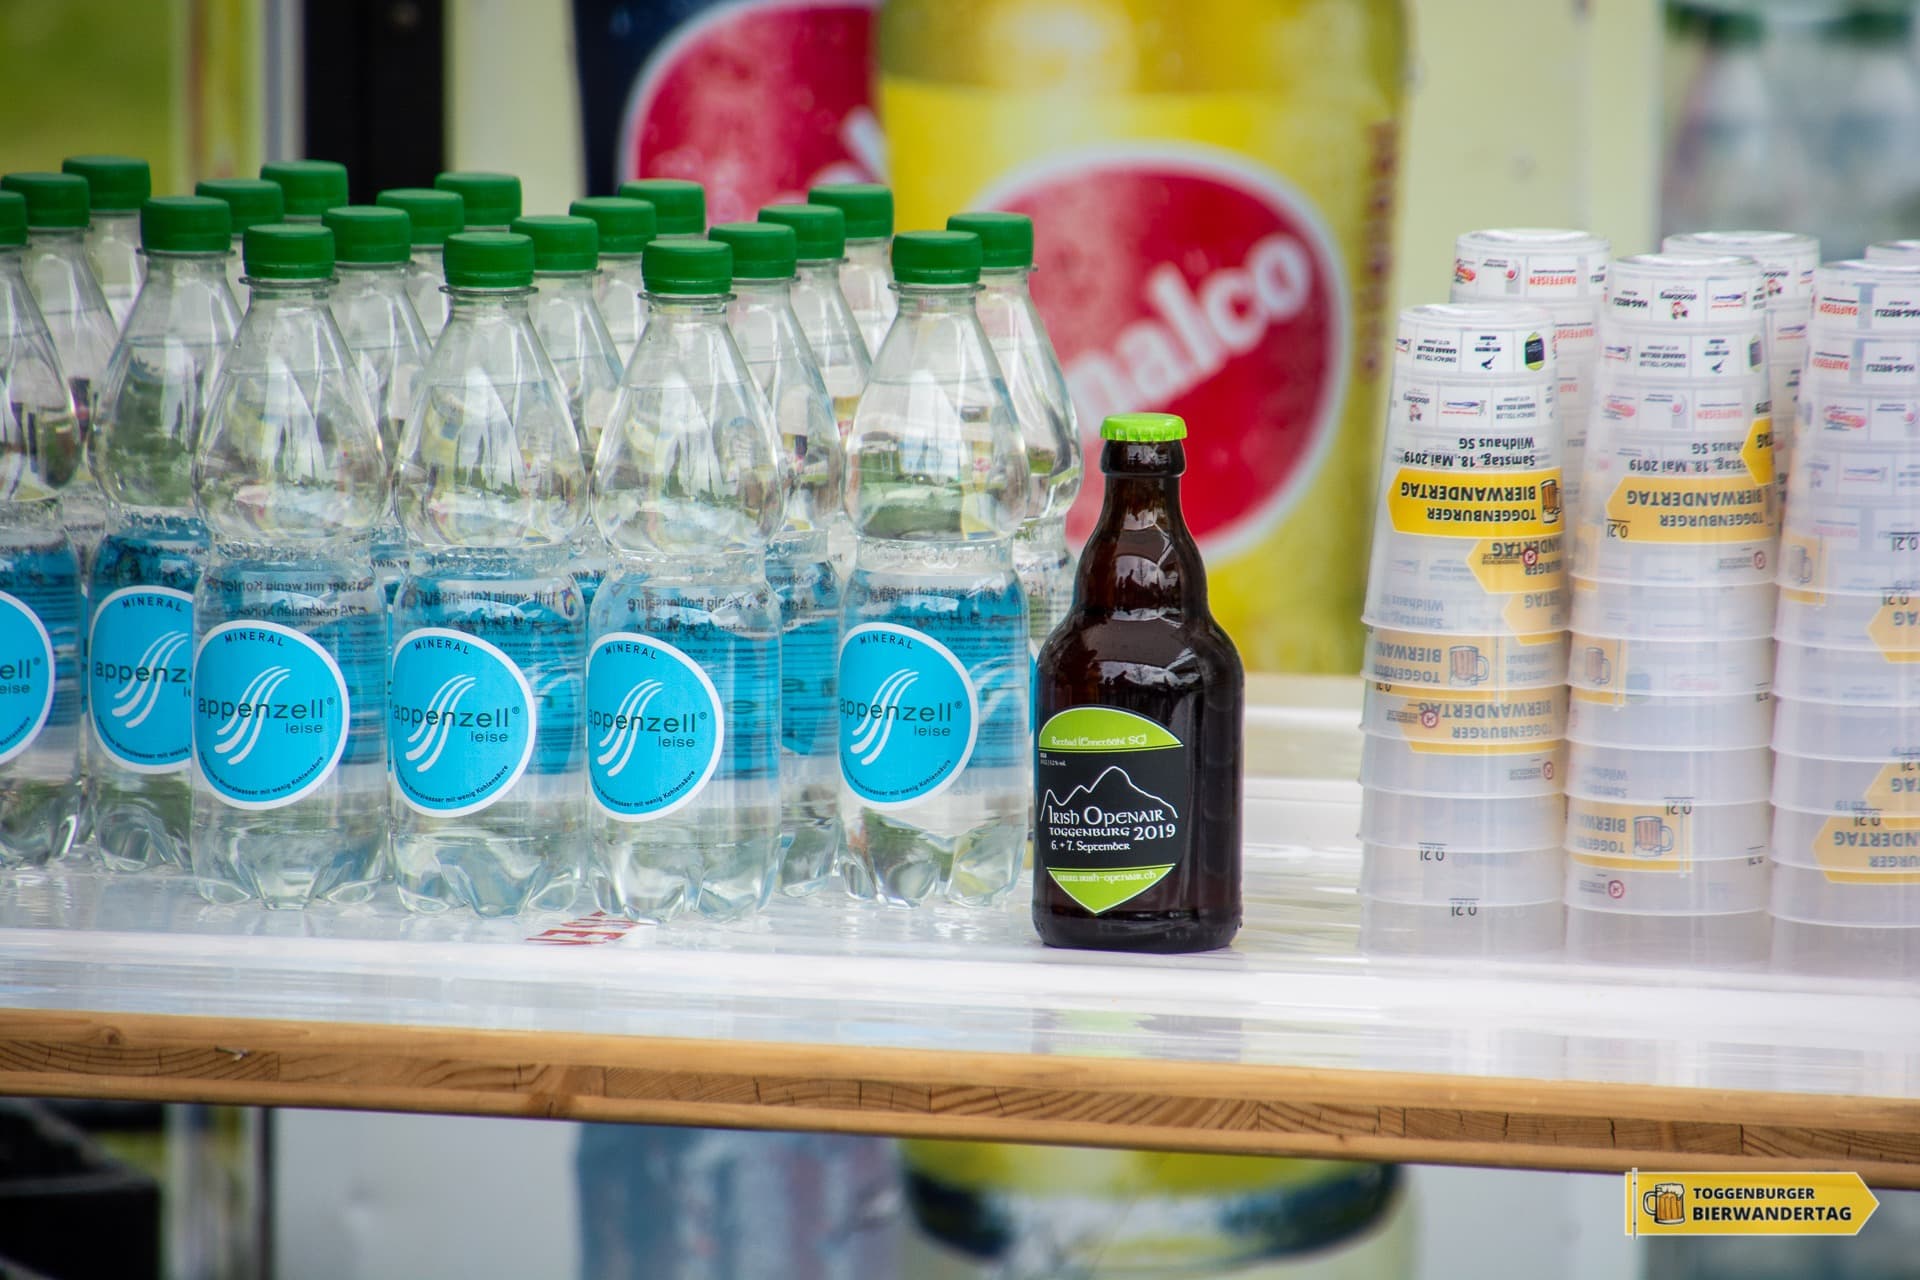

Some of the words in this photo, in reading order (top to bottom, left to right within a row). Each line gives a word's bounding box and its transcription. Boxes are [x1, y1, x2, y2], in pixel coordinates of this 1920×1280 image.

[1064, 234, 1310, 434] nalco
[1459, 437, 1475, 450] SG
[1479, 437, 1534, 450] Wildhaus
[1691, 443, 1708, 455] SG
[1712, 442, 1744, 454] haus
[1404, 451, 1428, 465] 2019
[1431, 454, 1453, 467] Mai
[1457, 455, 1476, 468] 18.
[1480, 453, 1535, 467] Samstag,
[1629, 460, 1658, 472] 2019
[1662, 460, 1687, 473] Mai
[1401, 482, 1536, 501] BIERWANDERTAG
[1627, 489, 1763, 507] BIERWANDERTAG
[1427, 508, 1536, 523] TOGGENBURGER
[1660, 512, 1764, 527] TOGGENBURGER
[122, 596, 183, 612] MINERAL
[224, 632, 284, 647] MINERAL
[860, 633, 913, 649] MINERAL
[414, 639, 469, 654] MINERAL
[605, 643, 657, 660] MINERAL
[95, 660, 191, 684] appenz
[0, 684, 31, 695] eise
[1418, 700, 1552, 719] BIERWANDERTAG
[285, 722, 324, 735] leise
[914, 725, 951, 737] leise
[470, 731, 509, 743] leise
[658, 736, 696, 748] leise
[1134, 823, 1176, 840] 2019
[1051, 840, 1058, 850] 6.
[1066, 840, 1075, 851] 7.
[1076, 841, 1131, 853] September
[1869, 856, 1920, 868] URGER
